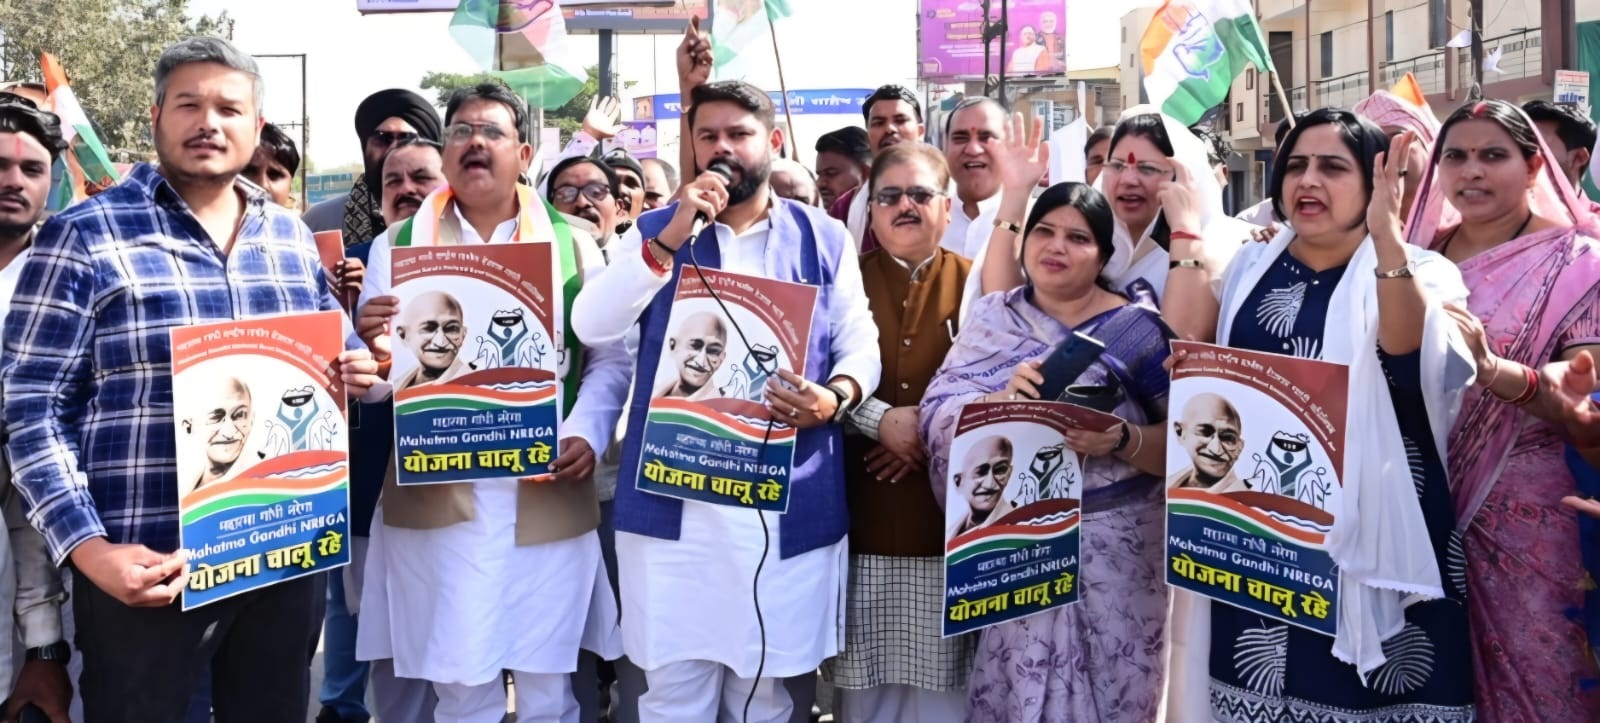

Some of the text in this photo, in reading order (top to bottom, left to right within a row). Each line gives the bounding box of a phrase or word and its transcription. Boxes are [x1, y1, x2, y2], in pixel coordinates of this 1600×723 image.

[400, 426, 553, 446] Mahatma Gandhi NREGA
[404, 442, 552, 472] योजना चालू रहे
[645, 443, 695, 463] Mahatma
[699, 454, 740, 471] Gandhi
[644, 459, 783, 504] योजना चालू रहे
[187, 512, 345, 560] Mahatma Gandhi NREGA
[189, 531, 342, 590] योजना चालू रहे
[1001, 565, 1038, 583] Gandhi
[1041, 555, 1076, 574] NREGA
[1169, 535, 1333, 592] Mahatma Gandhi NREGA
[950, 573, 1074, 621] योजना चालू रहे
[1172, 553, 1330, 619] योजना चालू रहे
